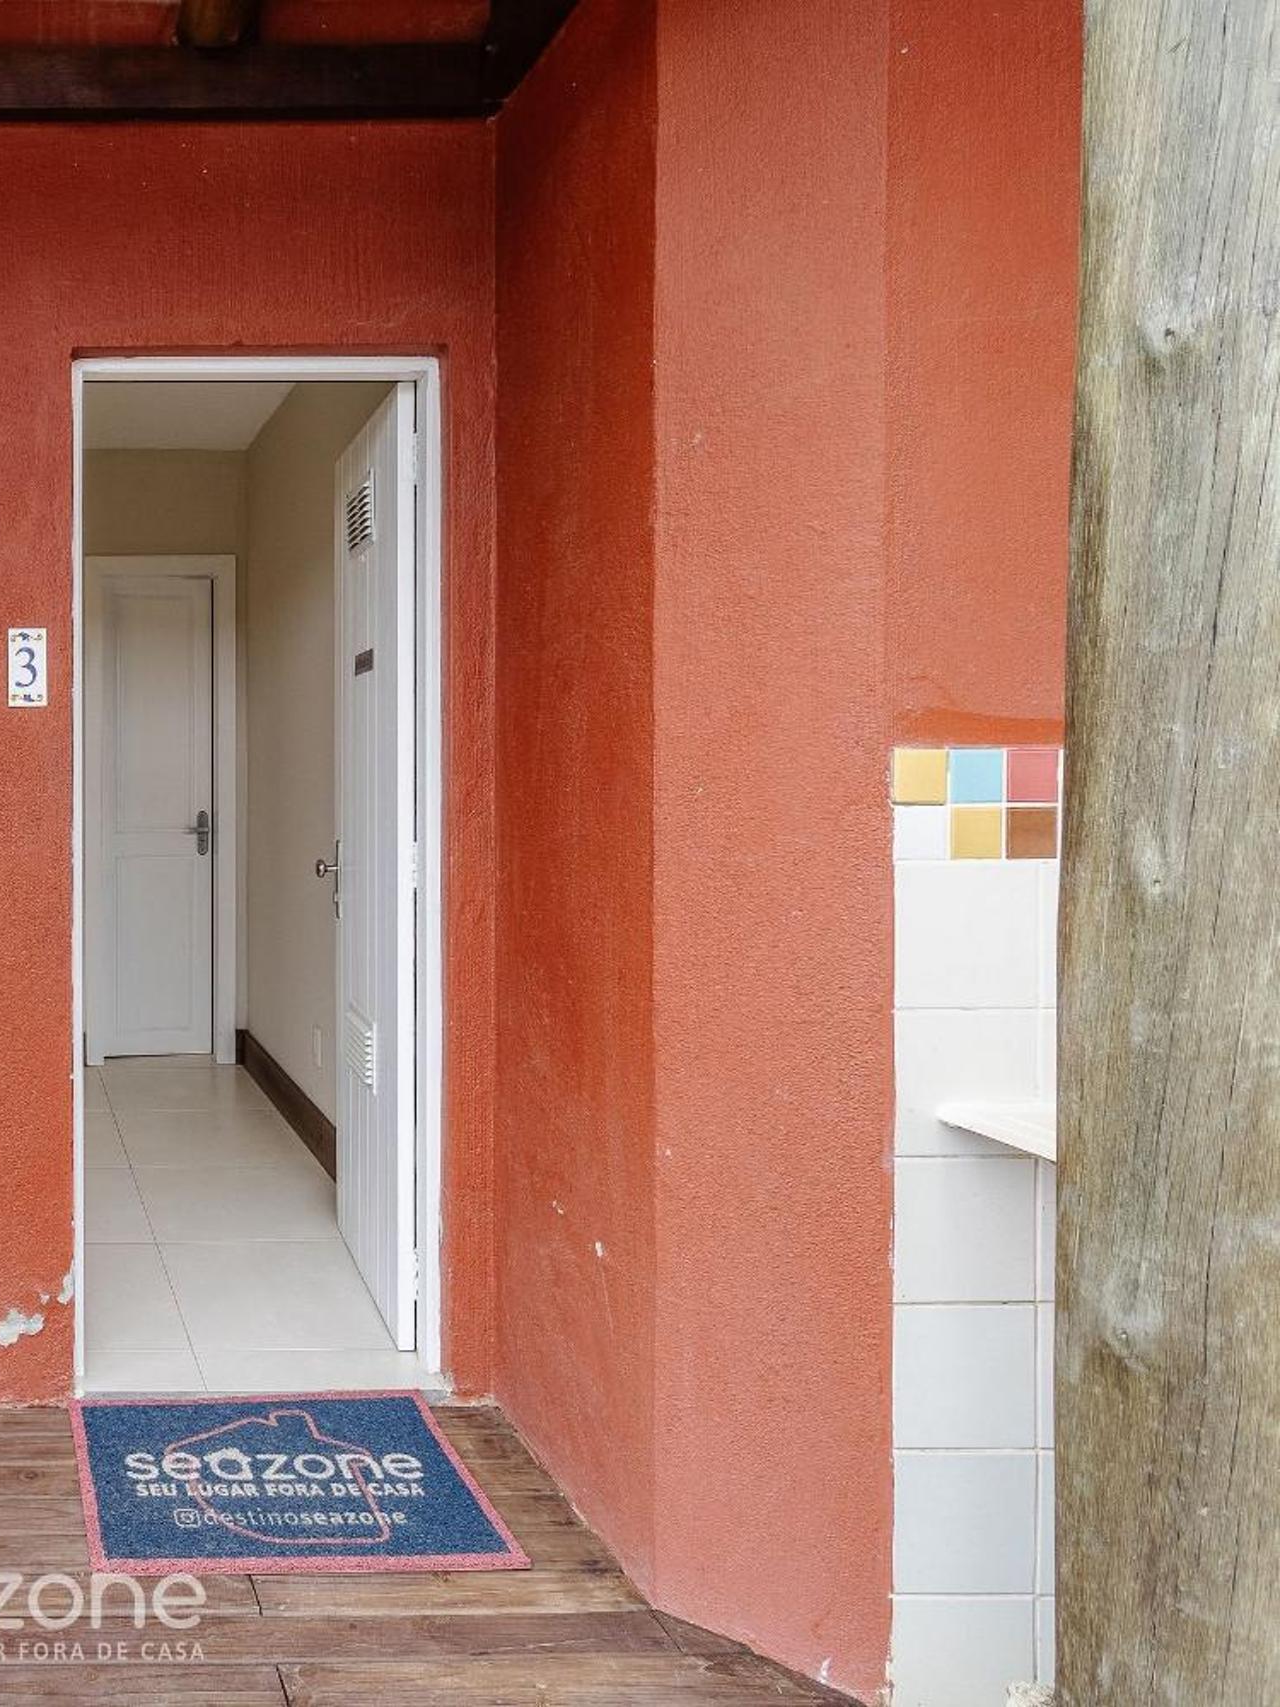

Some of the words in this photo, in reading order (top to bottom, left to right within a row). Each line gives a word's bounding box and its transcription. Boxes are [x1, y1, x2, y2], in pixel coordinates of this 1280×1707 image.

[15, 646, 37, 688] 3
[124, 1448, 424, 1481] seazone
[136, 1483, 178, 1498] SEU
[187, 1483, 260, 1498] LUGAR
[264, 1483, 325, 1498] FORA
[330, 1482, 363, 1497] DE
[368, 1482, 425, 1497] CASA
